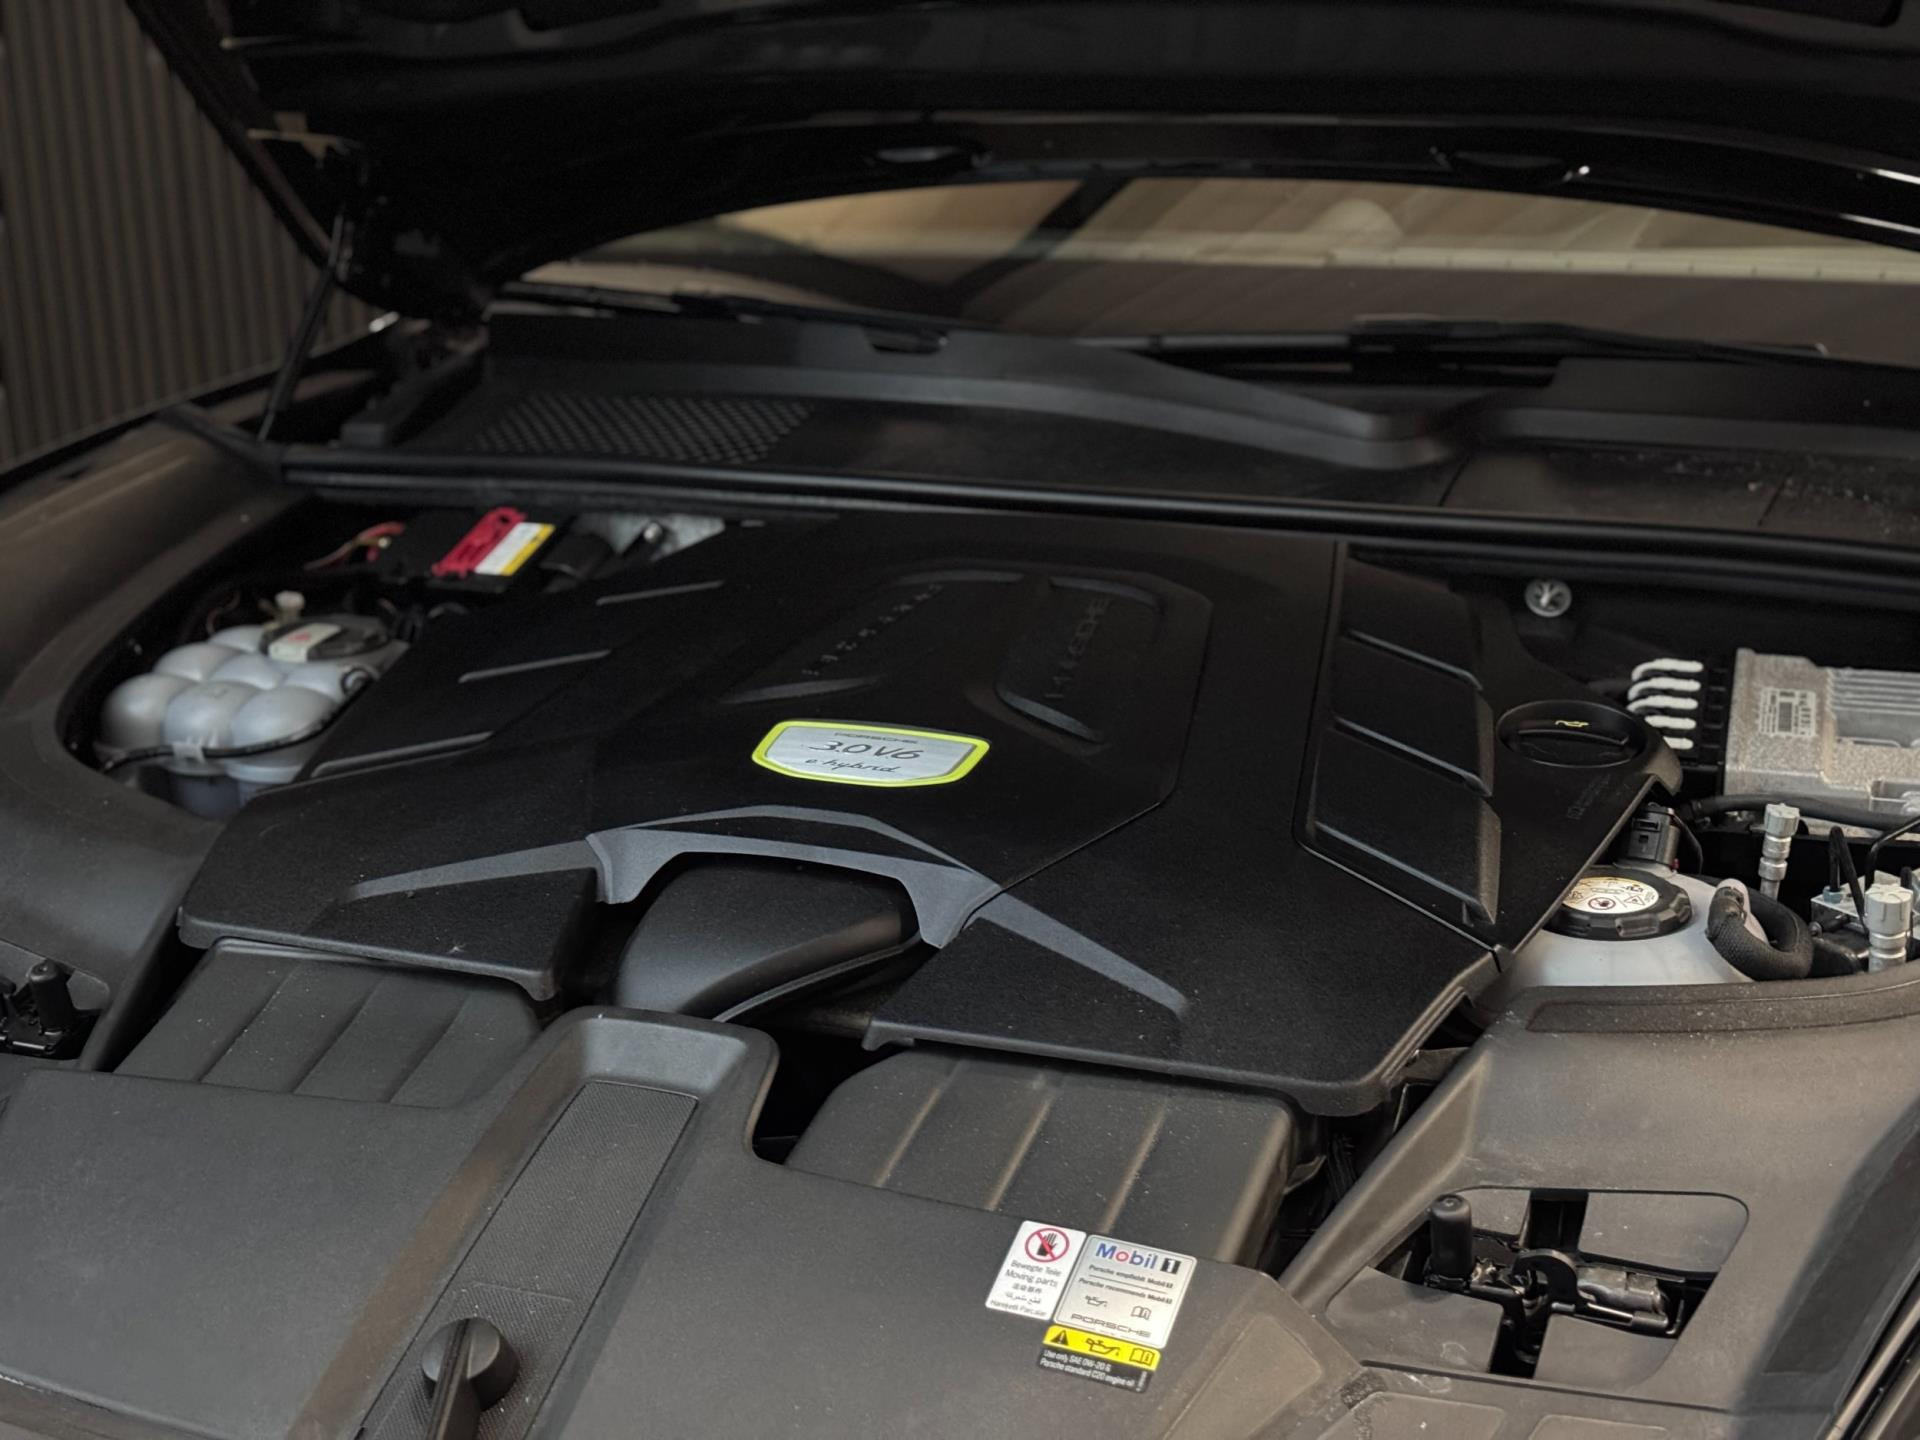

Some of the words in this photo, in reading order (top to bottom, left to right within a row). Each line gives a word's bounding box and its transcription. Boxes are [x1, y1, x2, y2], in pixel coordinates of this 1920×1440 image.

[808, 740, 872, 754] 3.0
[873, 746, 924, 759] V6
[1096, 1243, 1158, 1269] Mobil
[1005, 1269, 1034, 1283] Moving
[1035, 1277, 1058, 1288] parts
[1089, 1264, 1114, 1275] Porsche
[1079, 1277, 1104, 1288] Porsche
[1071, 1313, 1151, 1338] PORSCHE
